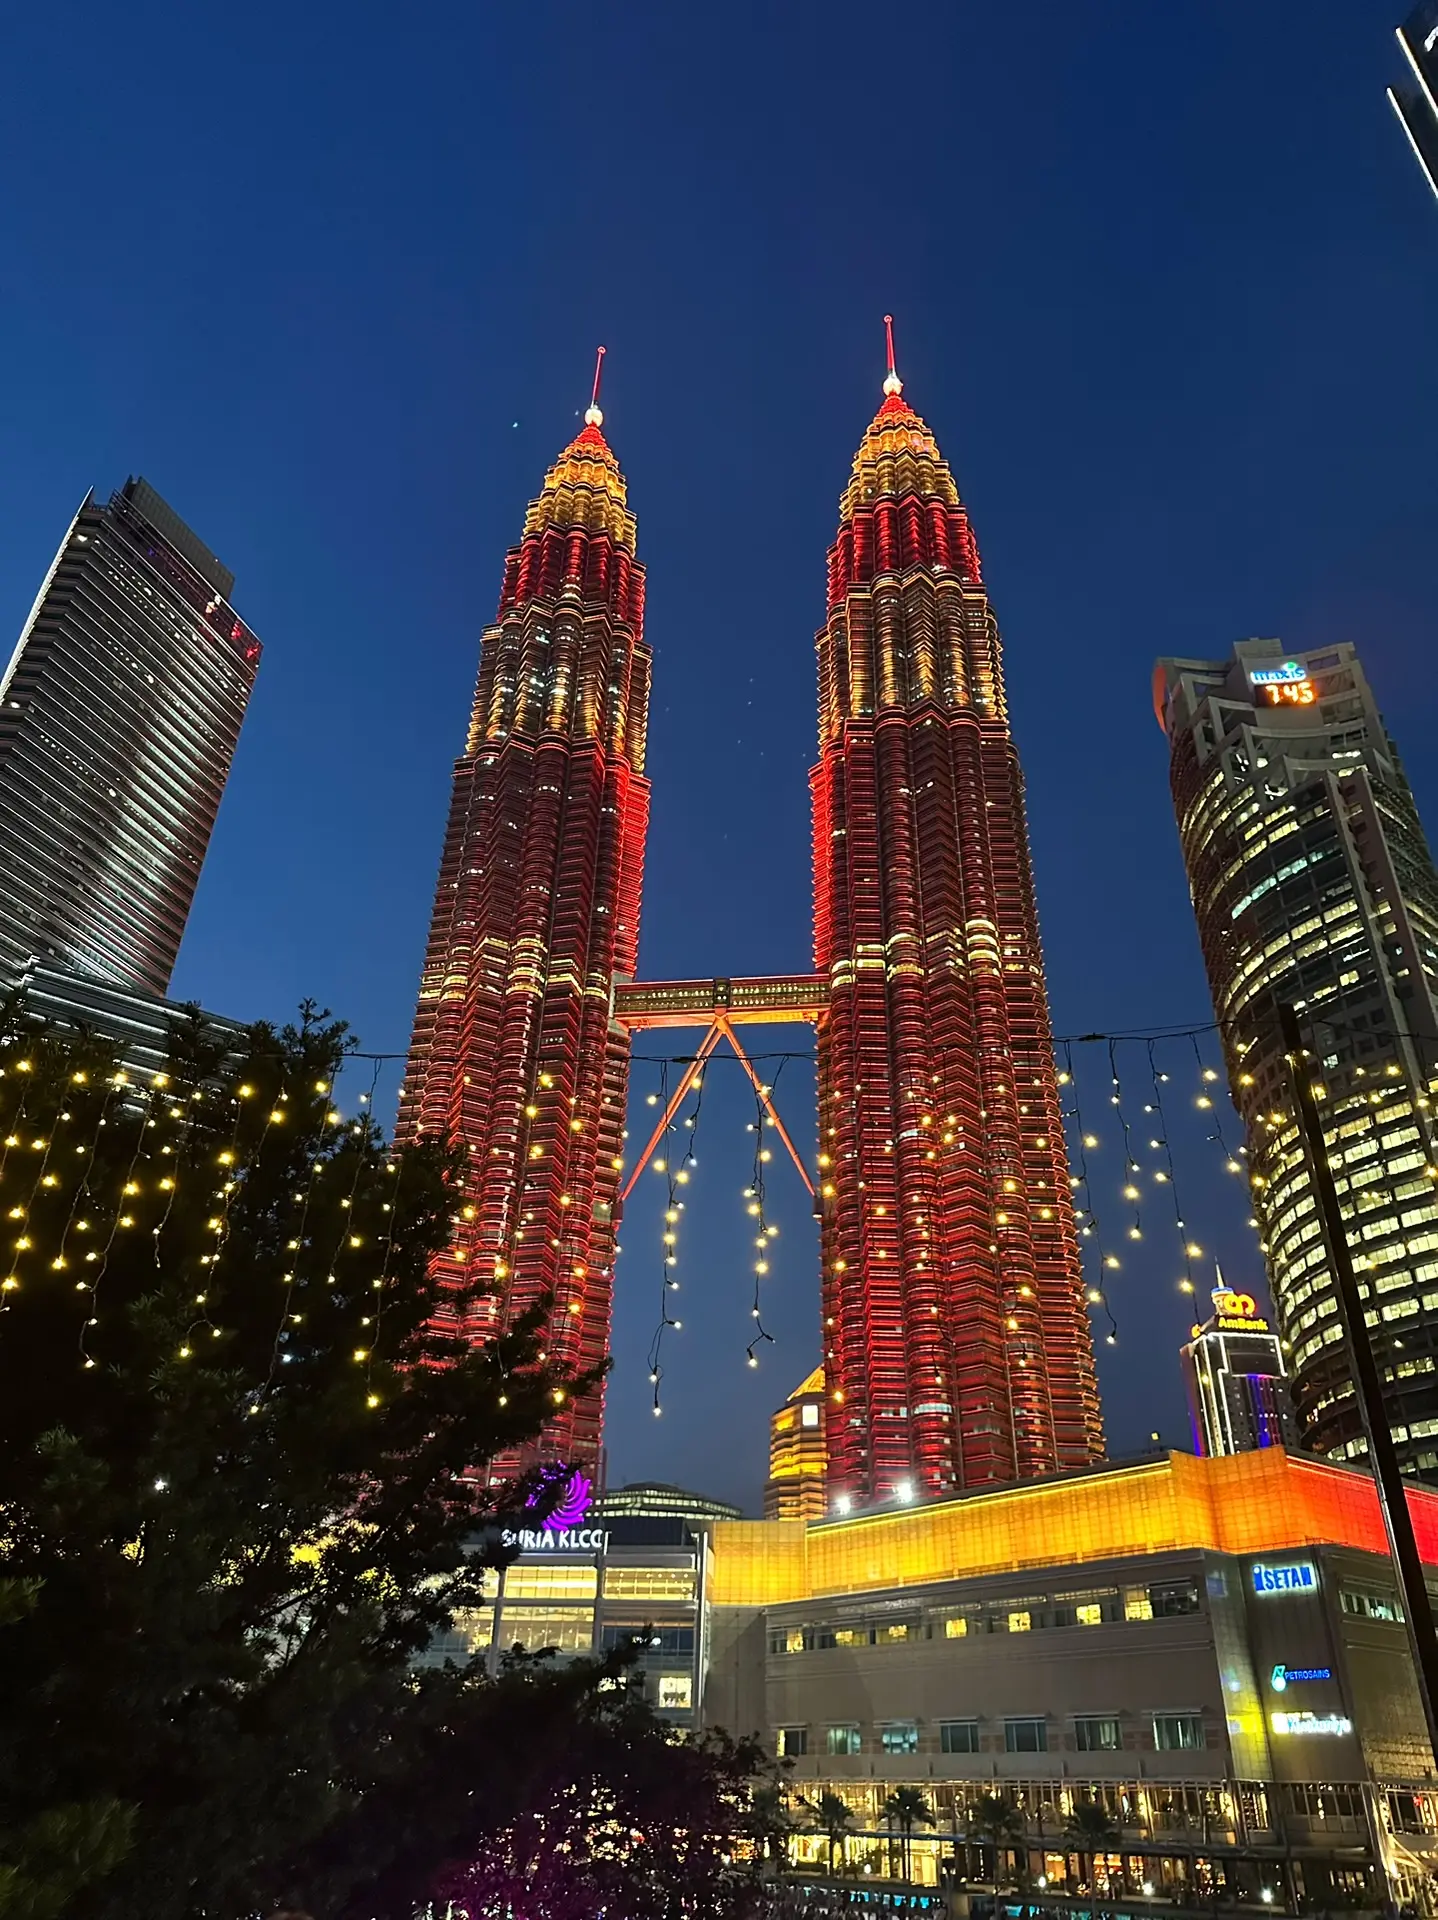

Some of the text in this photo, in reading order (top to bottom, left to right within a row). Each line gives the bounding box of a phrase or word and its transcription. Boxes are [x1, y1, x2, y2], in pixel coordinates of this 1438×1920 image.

[1265, 682, 1314, 704] 7:45
[1218, 1317, 1269, 1331] AmBank
[501, 1529, 603, 1549] SURIA KLCC
[1284, 1669, 1331, 1680] PETROSAINS
